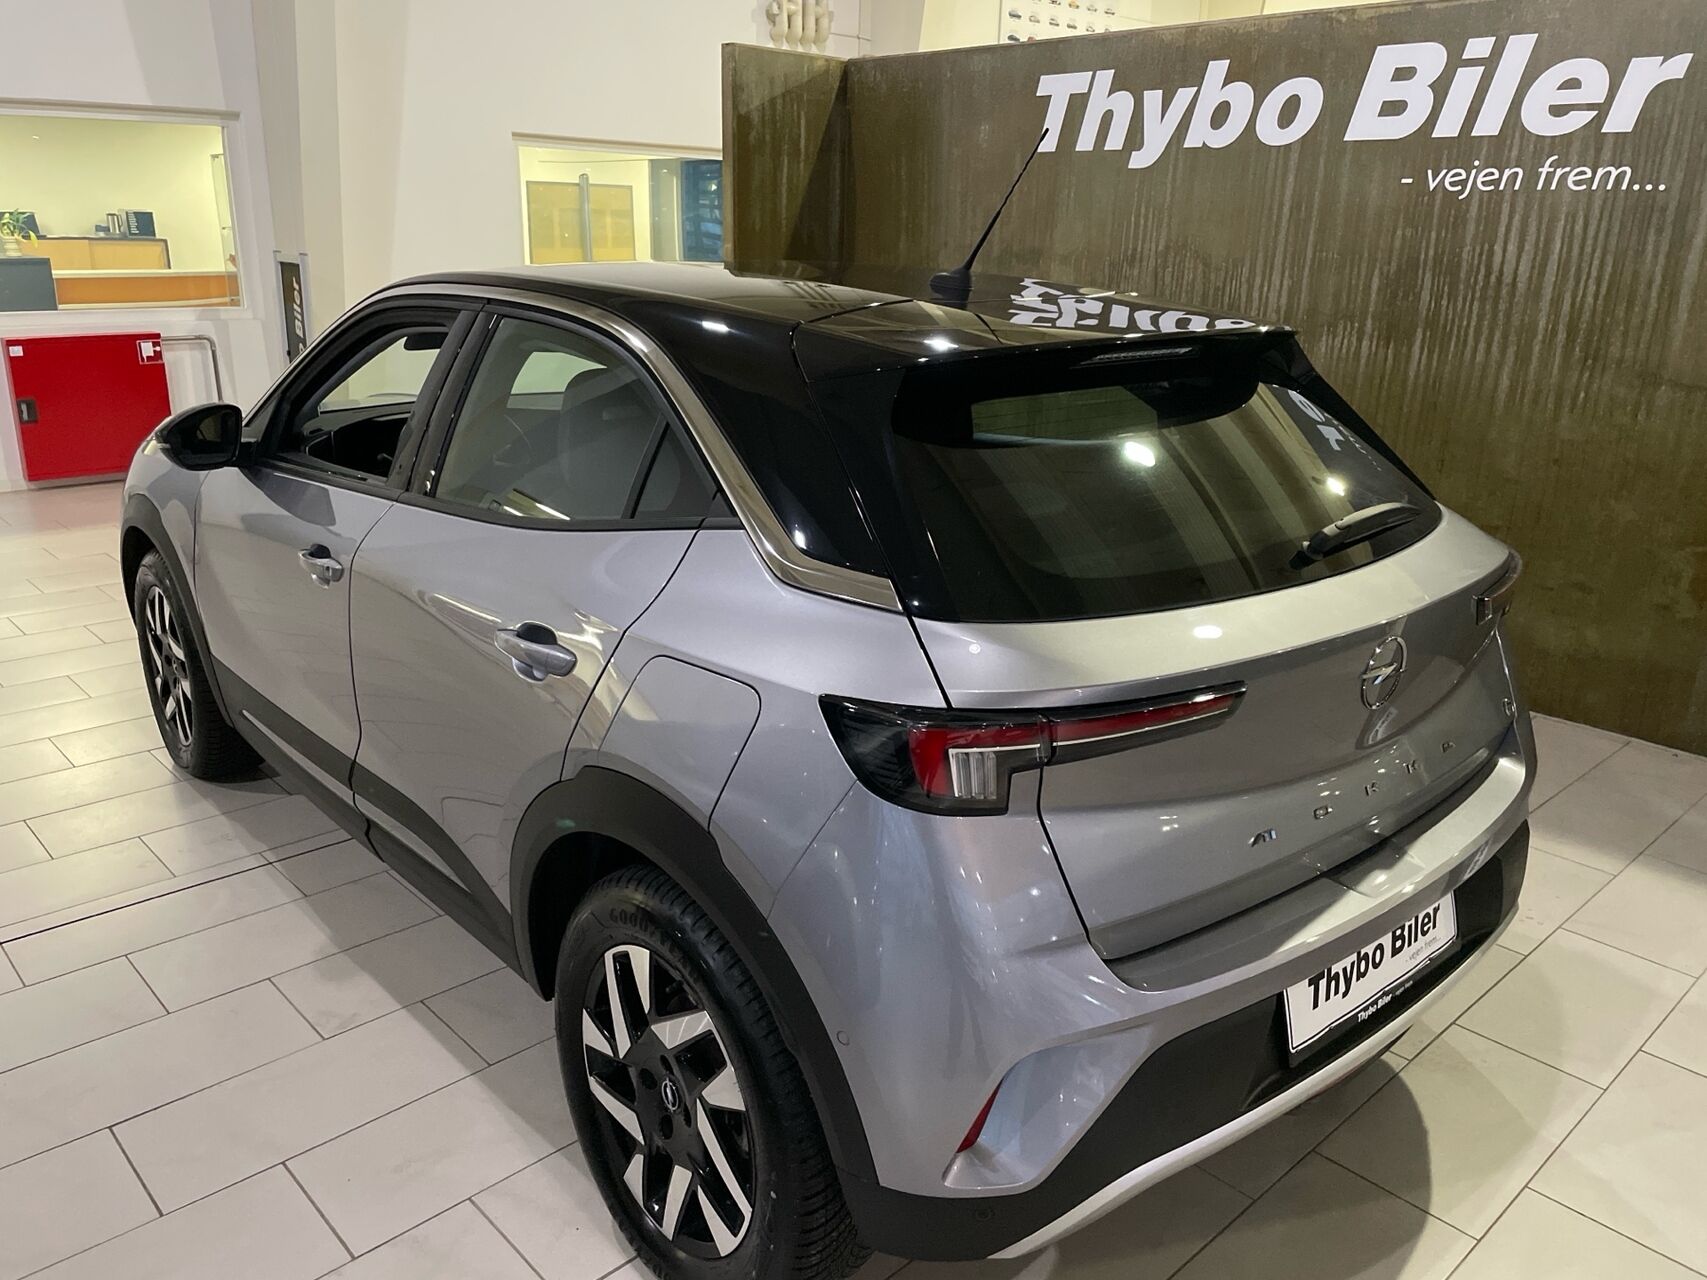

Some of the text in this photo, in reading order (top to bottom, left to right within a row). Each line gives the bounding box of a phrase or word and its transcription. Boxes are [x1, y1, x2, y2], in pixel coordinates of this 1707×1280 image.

[1036, 33, 1695, 170] Thybo Biler
[1427, 160, 1524, 200] vejen
[1537, 155, 1667, 192] frem...
[292, 276, 305, 339] Biler
[1307, 903, 1441, 1011] Thybo Biler
